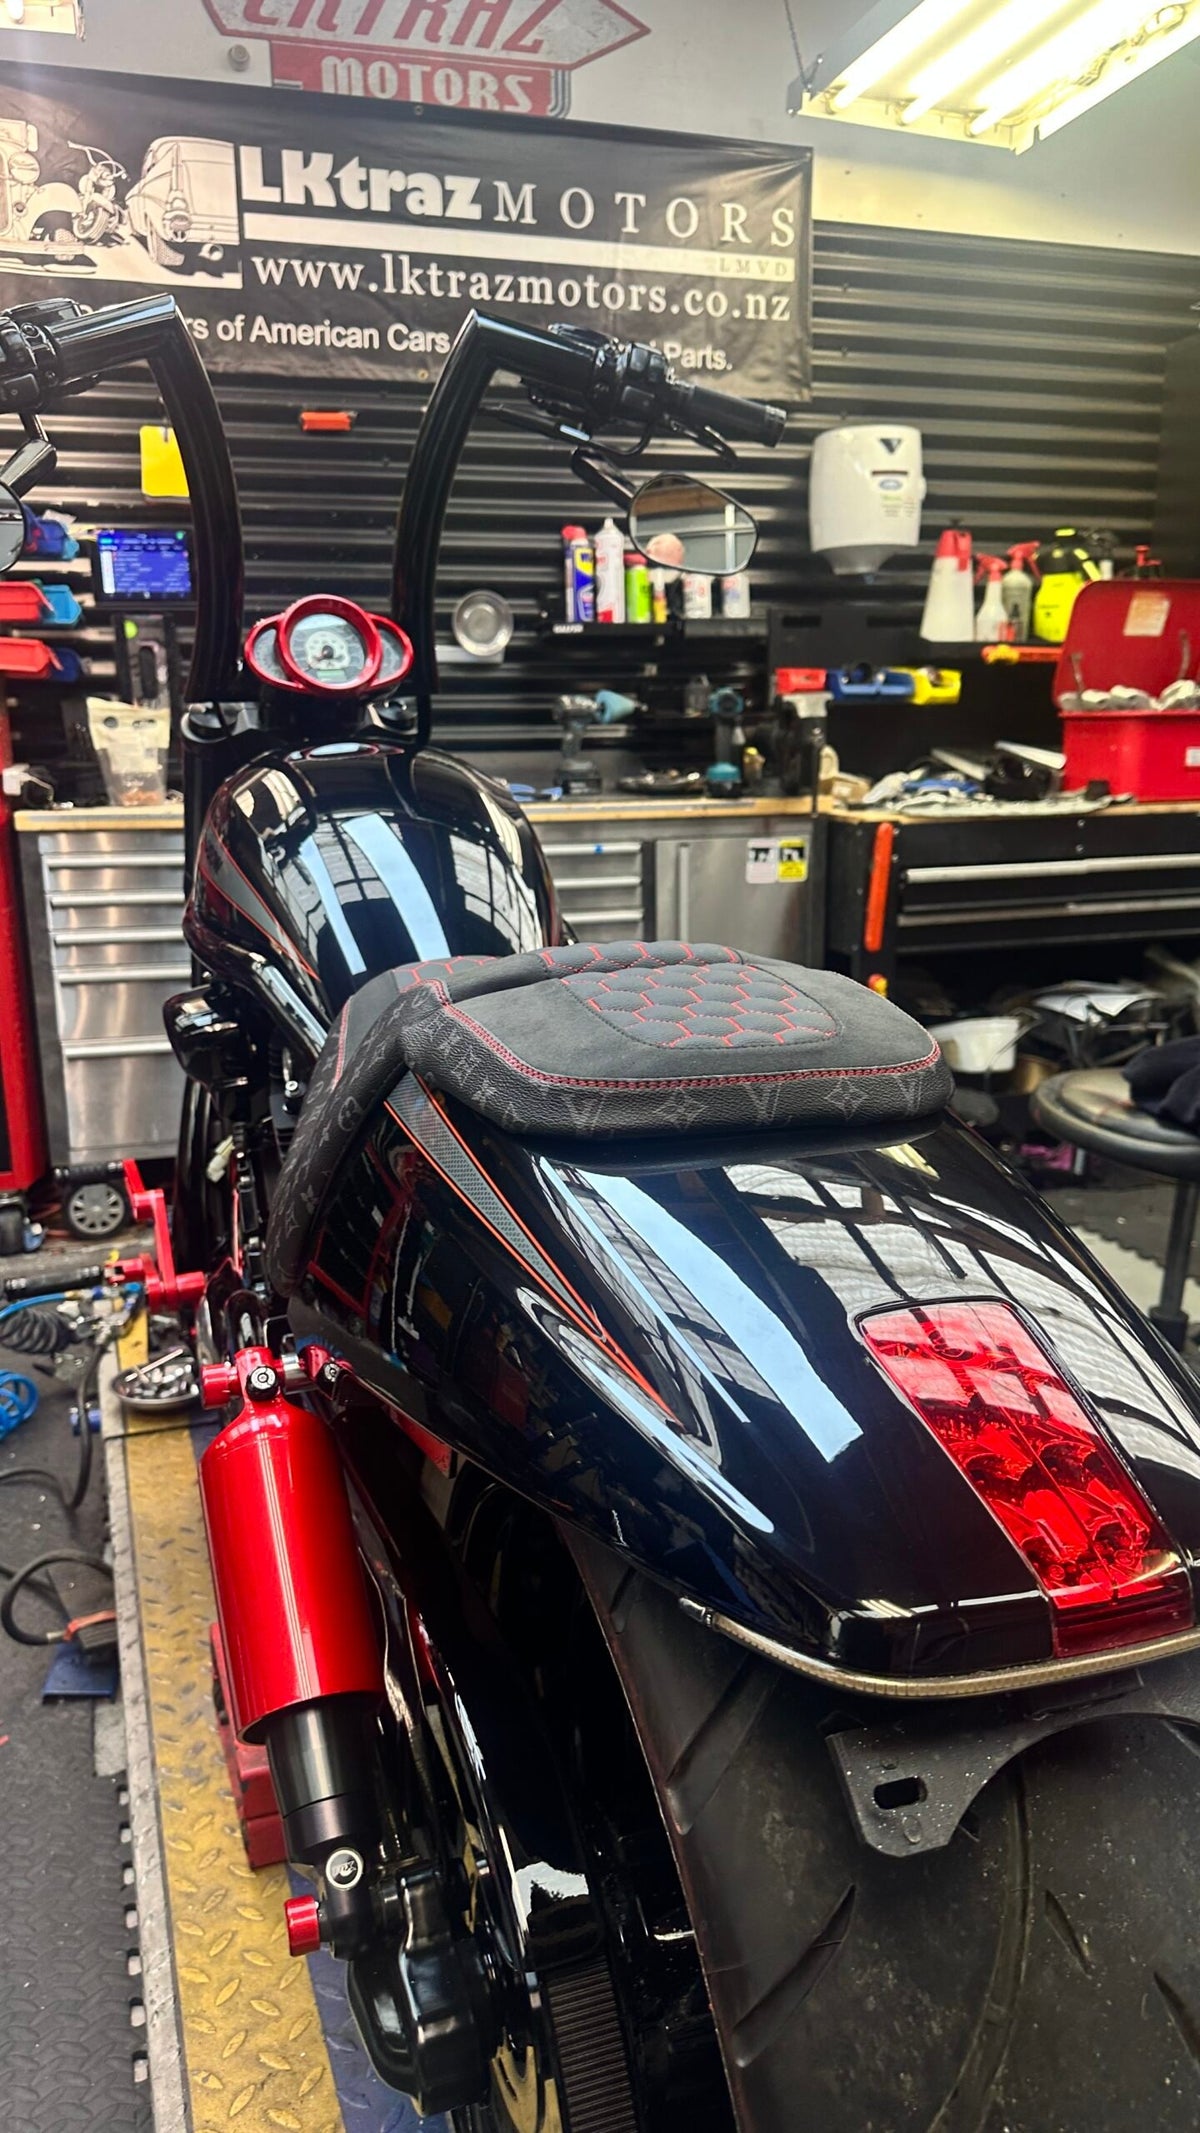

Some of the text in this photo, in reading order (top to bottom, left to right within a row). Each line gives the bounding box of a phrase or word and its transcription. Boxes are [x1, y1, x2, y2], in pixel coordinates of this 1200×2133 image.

[321, 55, 533, 113] MOTORS
[239, 145, 795, 247] LKtraz MOTORS
[251, 253, 790, 321] www.lktrazmotors.co.nz
[720, 257, 787, 276] LMVD
[216, 314, 246, 341] of
[250, 315, 379, 349] American
[387, 323, 450, 354] Cars
[664, 341, 733, 371] Parts.
